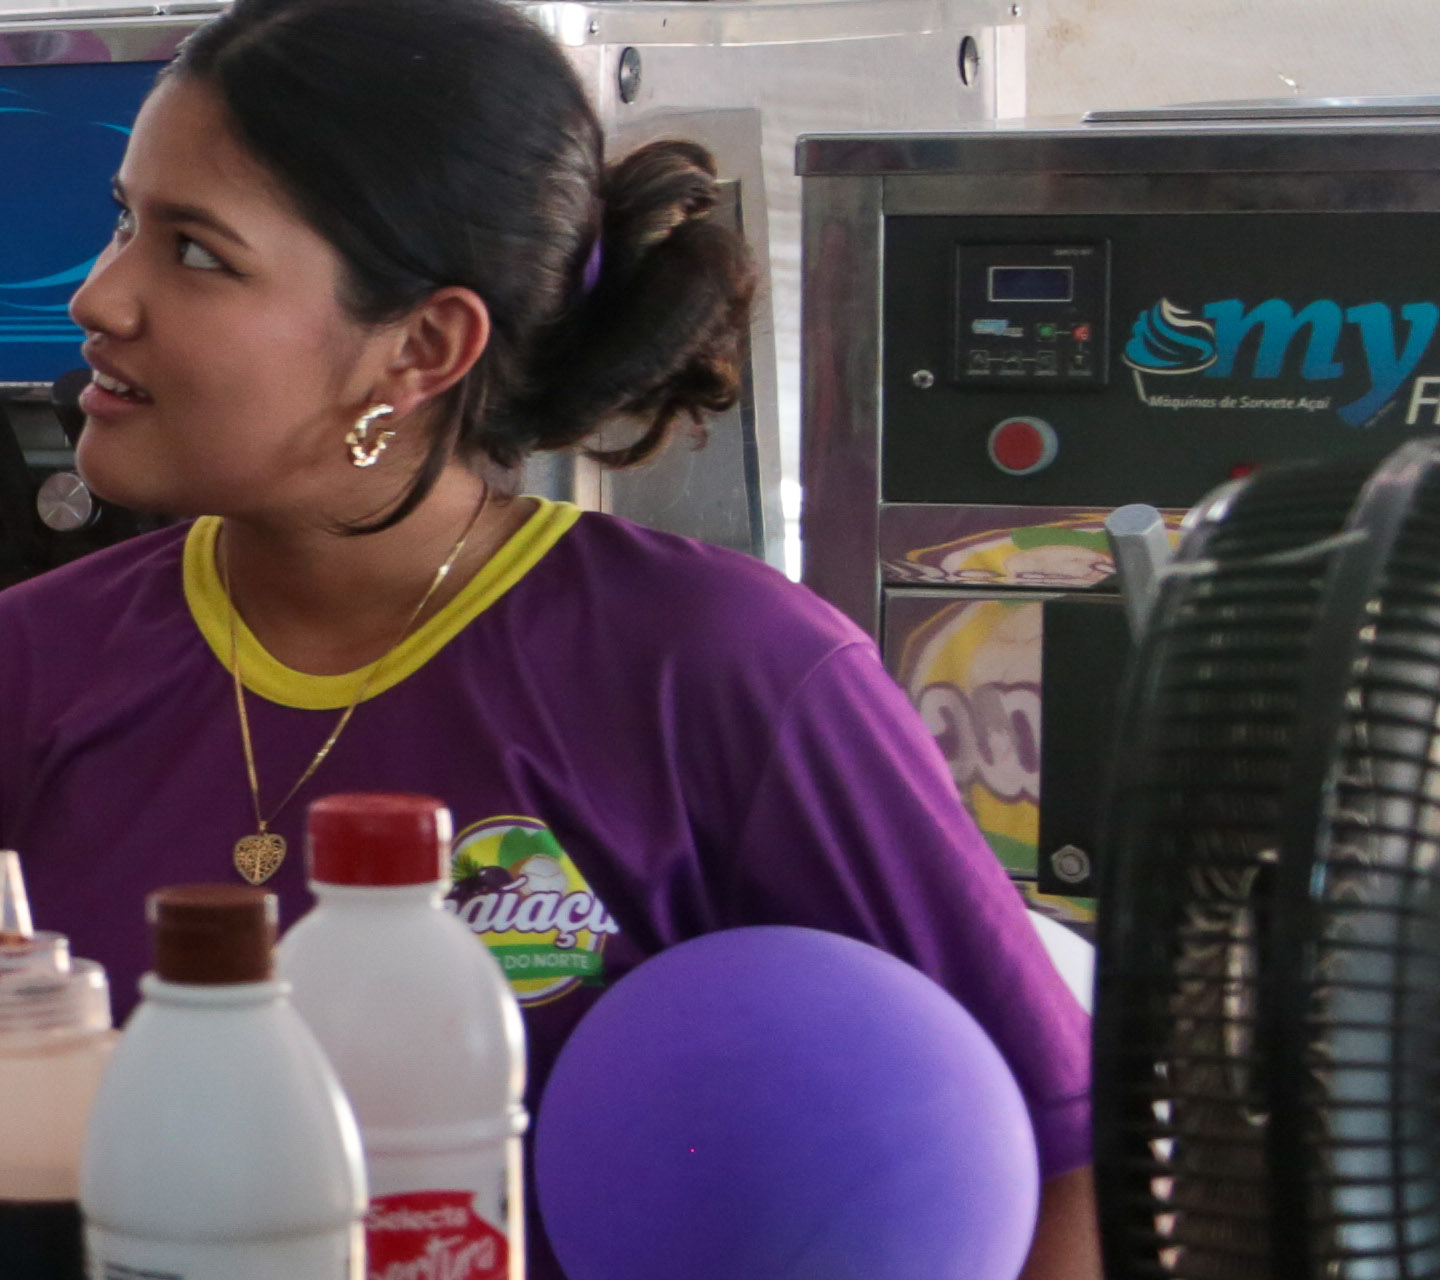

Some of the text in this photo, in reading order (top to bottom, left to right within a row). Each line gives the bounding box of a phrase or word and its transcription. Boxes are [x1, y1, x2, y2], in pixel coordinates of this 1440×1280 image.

[1203, 298, 1440, 427] my
[1220, 395, 1237, 407] de
[444, 874, 620, 949] aíaçu
[504, 954, 530, 969] DO
[534, 953, 589, 969] NORTE
